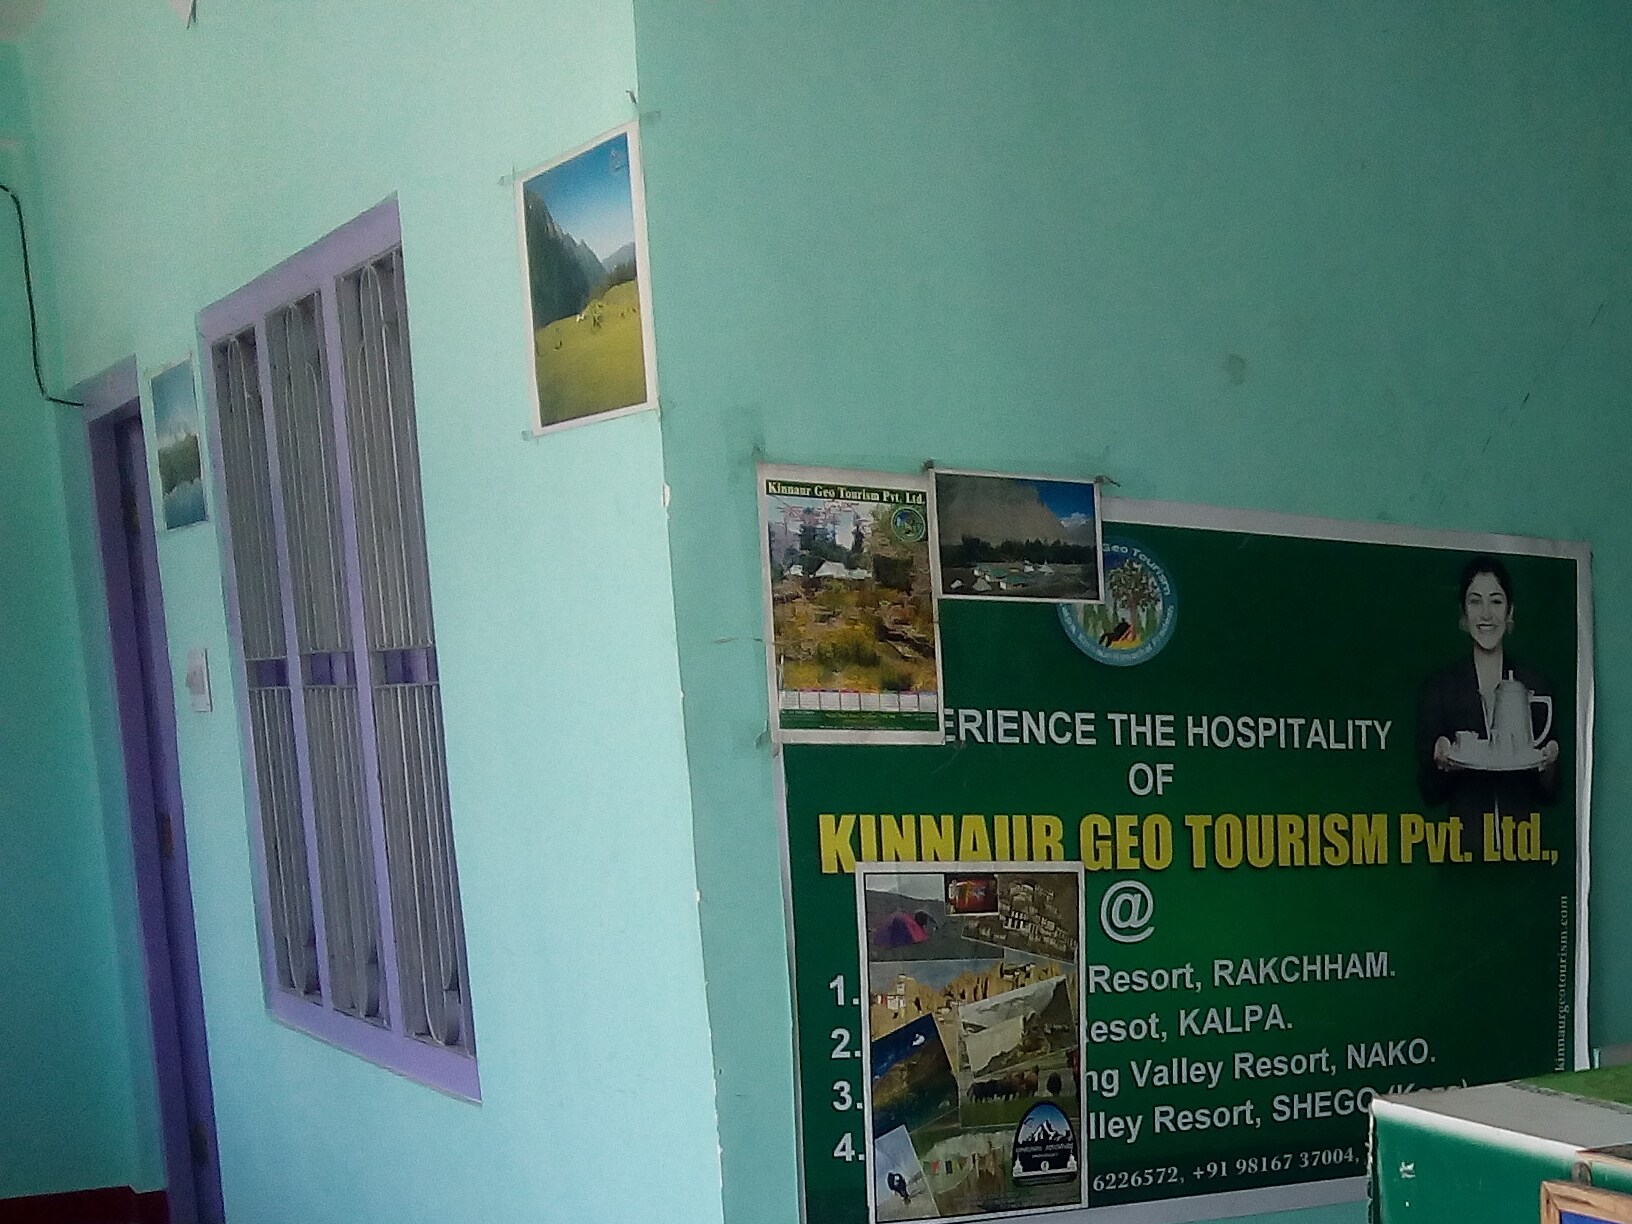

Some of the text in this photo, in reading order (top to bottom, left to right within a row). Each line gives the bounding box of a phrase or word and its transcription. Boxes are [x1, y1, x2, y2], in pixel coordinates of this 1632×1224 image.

[768, 482, 811, 496] Kinnaur
[814, 485, 836, 498] Geo
[838, 487, 880, 501] Tourism
[1132, 547, 1171, 596] Tourism
[1107, 712, 1176, 747] THE
[1187, 715, 1392, 751] HOSPITALITY
[1128, 762, 1175, 796] OF
[1079, 813, 1173, 872] GEO
[1185, 813, 1389, 869] TOURISM
[1400, 813, 1473, 864] Pvt.
[1483, 812, 1559, 866] Ltd.,
[1100, 879, 1156, 944] @
[829, 951, 1396, 1006] 1. Resort, RAKCHHAM.
[831, 1003, 1293, 1059] 2. esot, KALPA.
[832, 1080, 864, 1111] 3.
[1130, 1056, 1224, 1090] Valley
[1233, 1048, 1337, 1081] Resort,
[1346, 1037, 1436, 1070] NAKO.
[833, 1132, 865, 1162] 4.
[1153, 1099, 1261, 1134] Resort,
[1272, 1086, 1378, 1123] SHEGO
[1092, 1166, 1185, 1192] 6226572,
[1193, 1160, 1229, 1180] +91
[1236, 1153, 1292, 1176] 98167
[1299, 1147, 1360, 1169] 37004,
